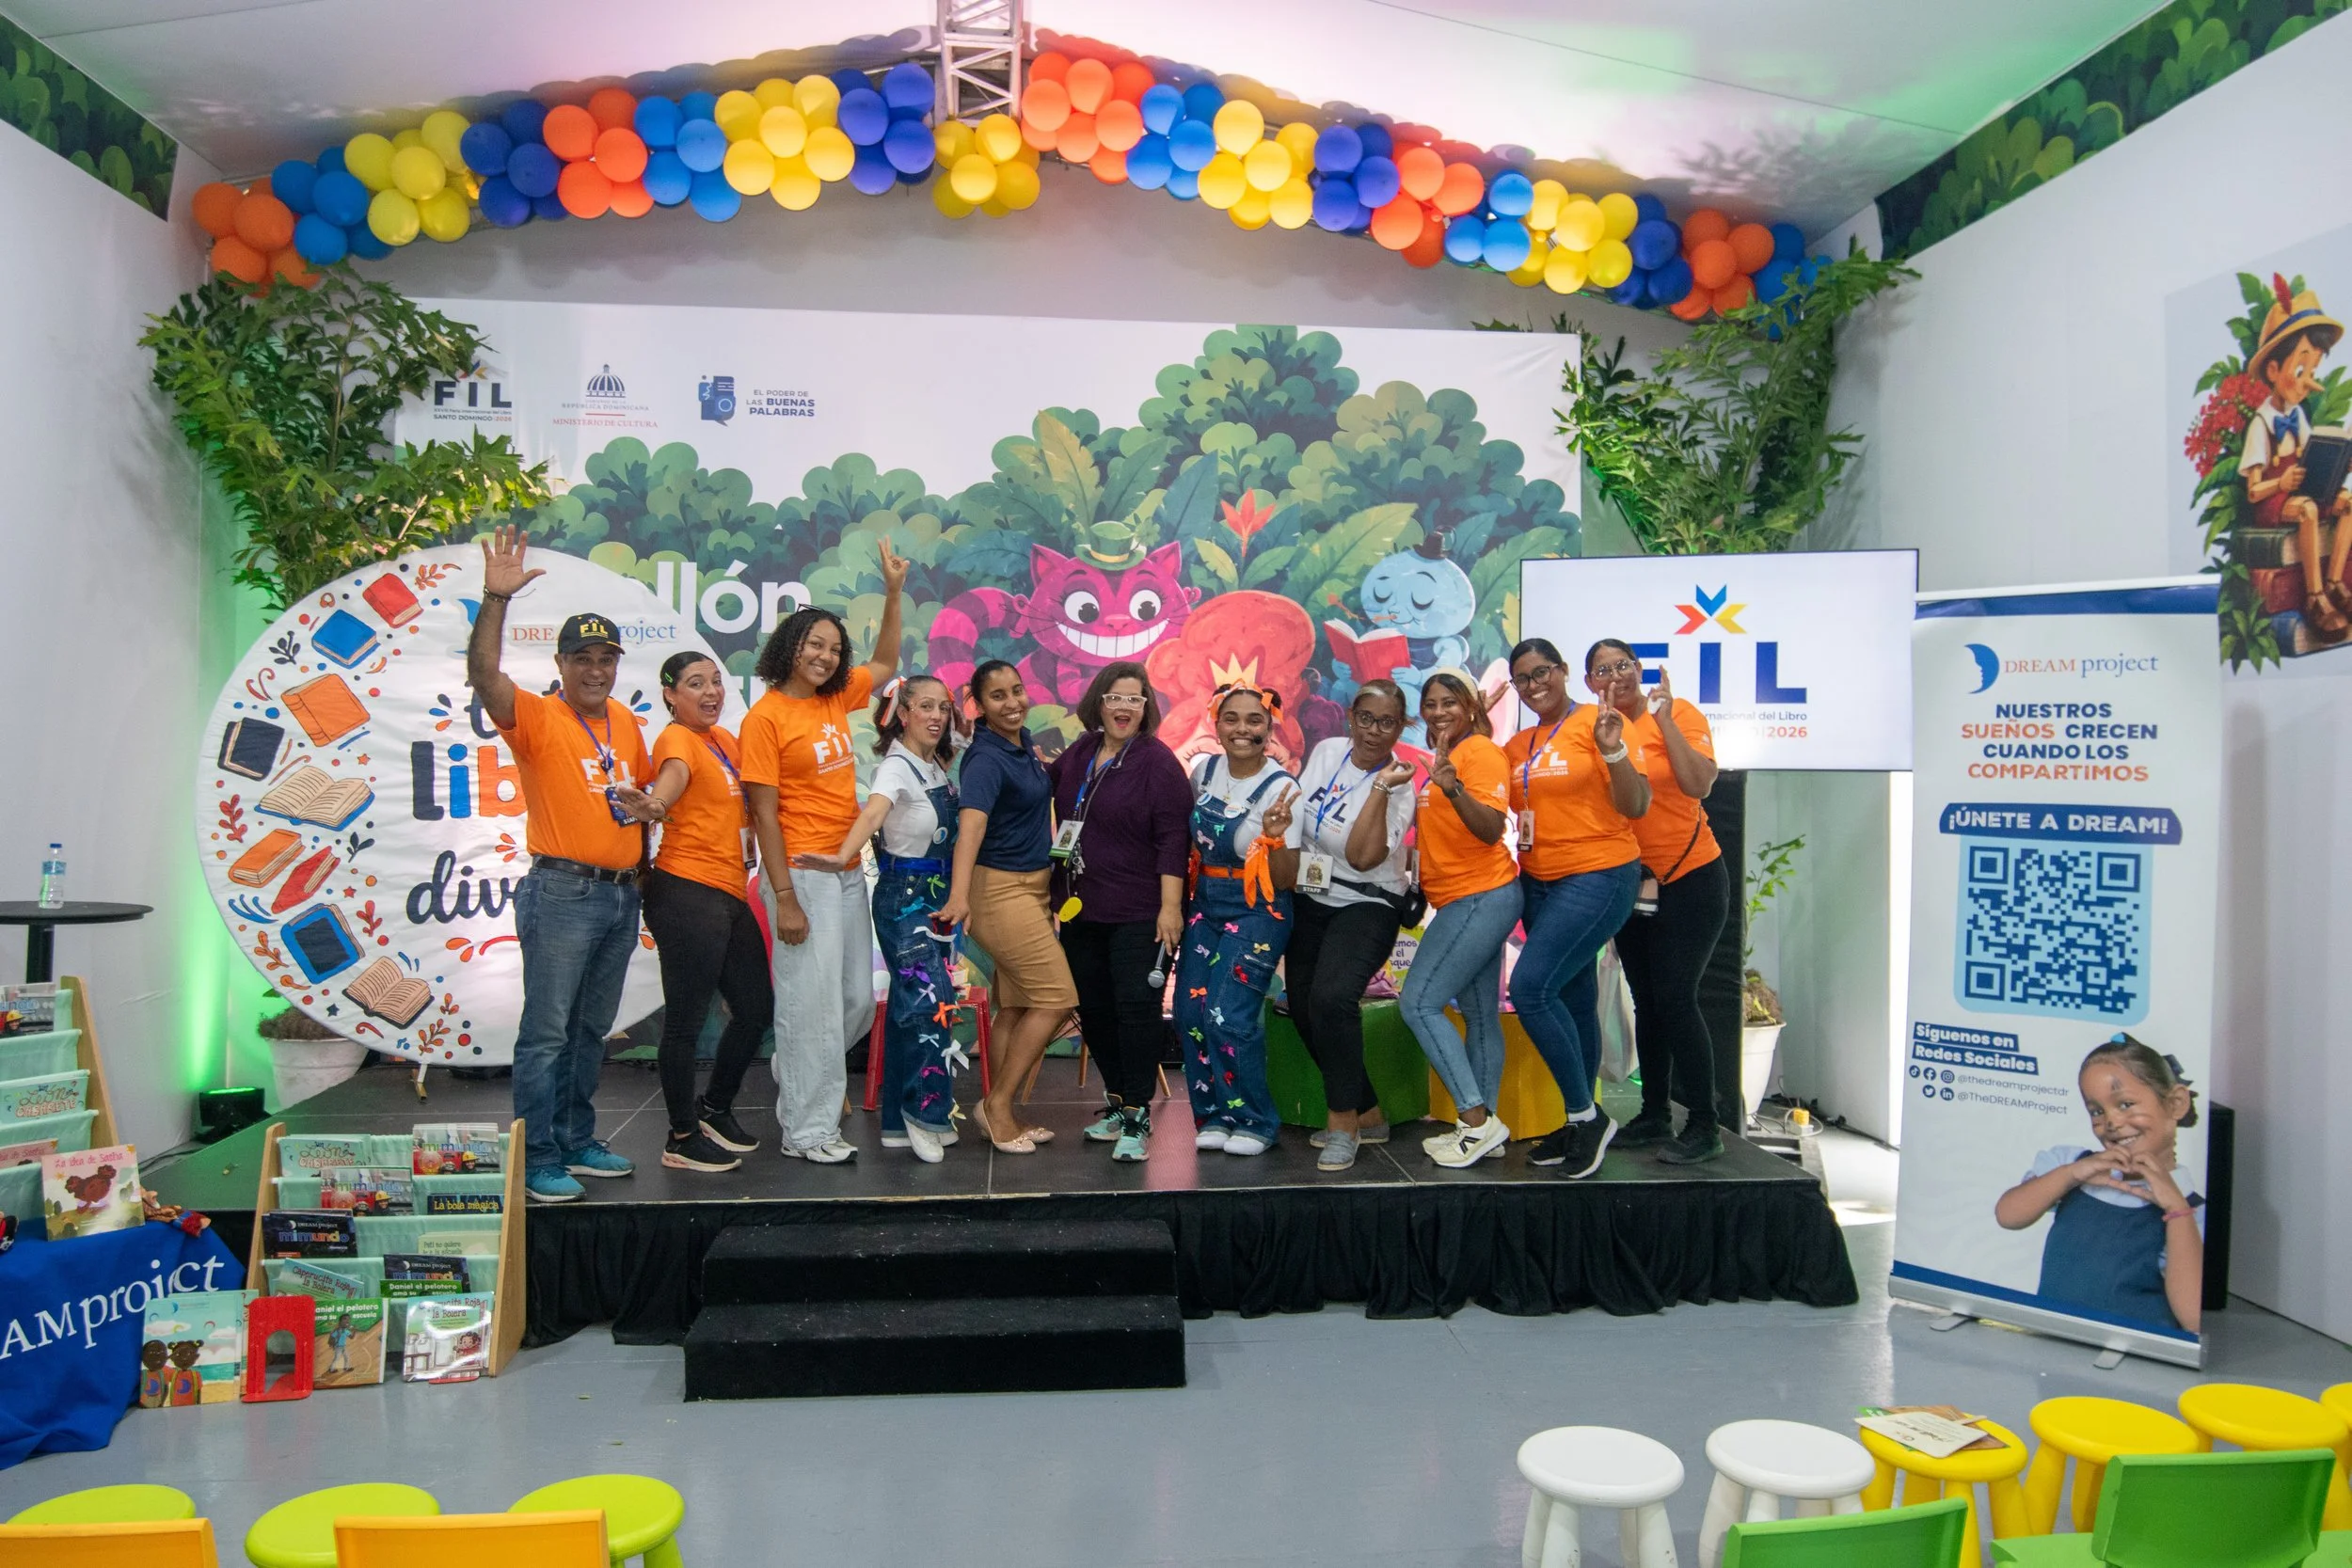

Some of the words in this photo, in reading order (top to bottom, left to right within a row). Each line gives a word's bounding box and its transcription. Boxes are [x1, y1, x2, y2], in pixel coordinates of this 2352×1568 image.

[434, 380, 512, 408] FIL
[766, 398, 815, 407] BUENAS
[749, 407, 815, 417] PALABRAS
[616, 420, 658, 428] CULTURA
[512, 627, 558, 641] DRE
[580, 622, 608, 635] FIL
[2005, 658, 2075, 673] DREAM
[2081, 653, 2158, 678] project
[1758, 712, 1776, 721] del
[1779, 711, 1807, 721] Libro
[1995, 703, 2112, 719] NUESTROS
[1767, 726, 1807, 737] 2026
[1962, 719, 2055, 739] SUEÑOS
[2065, 723, 2158, 740] CRECEN
[1982, 743, 2081, 759] CUANDO
[2087, 744, 2129, 760] LOS
[580, 758, 636, 789] FL
[1967, 763, 2149, 783] COMPARTIMOS
[1948, 806, 2031, 830] ¡ÚNETE
[2041, 814, 2058, 831] A
[2068, 814, 2169, 834] DREAM!
[1396, 948, 1405, 958] el
[1915, 1023, 1991, 1046] Síguenos
[1993, 1036, 2014, 1049] en
[1915, 1044, 1962, 1063] Redes
[1963, 1051, 2036, 1072] Sociales
[1958, 1074, 2069, 1097] @thedreamprojectdr
[1958, 1091, 2068, 1115] @TheDREAMProject
[434, 1200, 445, 1211] La
[425, 1283, 457, 1291] pelotero
[315, 1305, 334, 1313] aniel
[346, 1303, 379, 1312] pelotero
